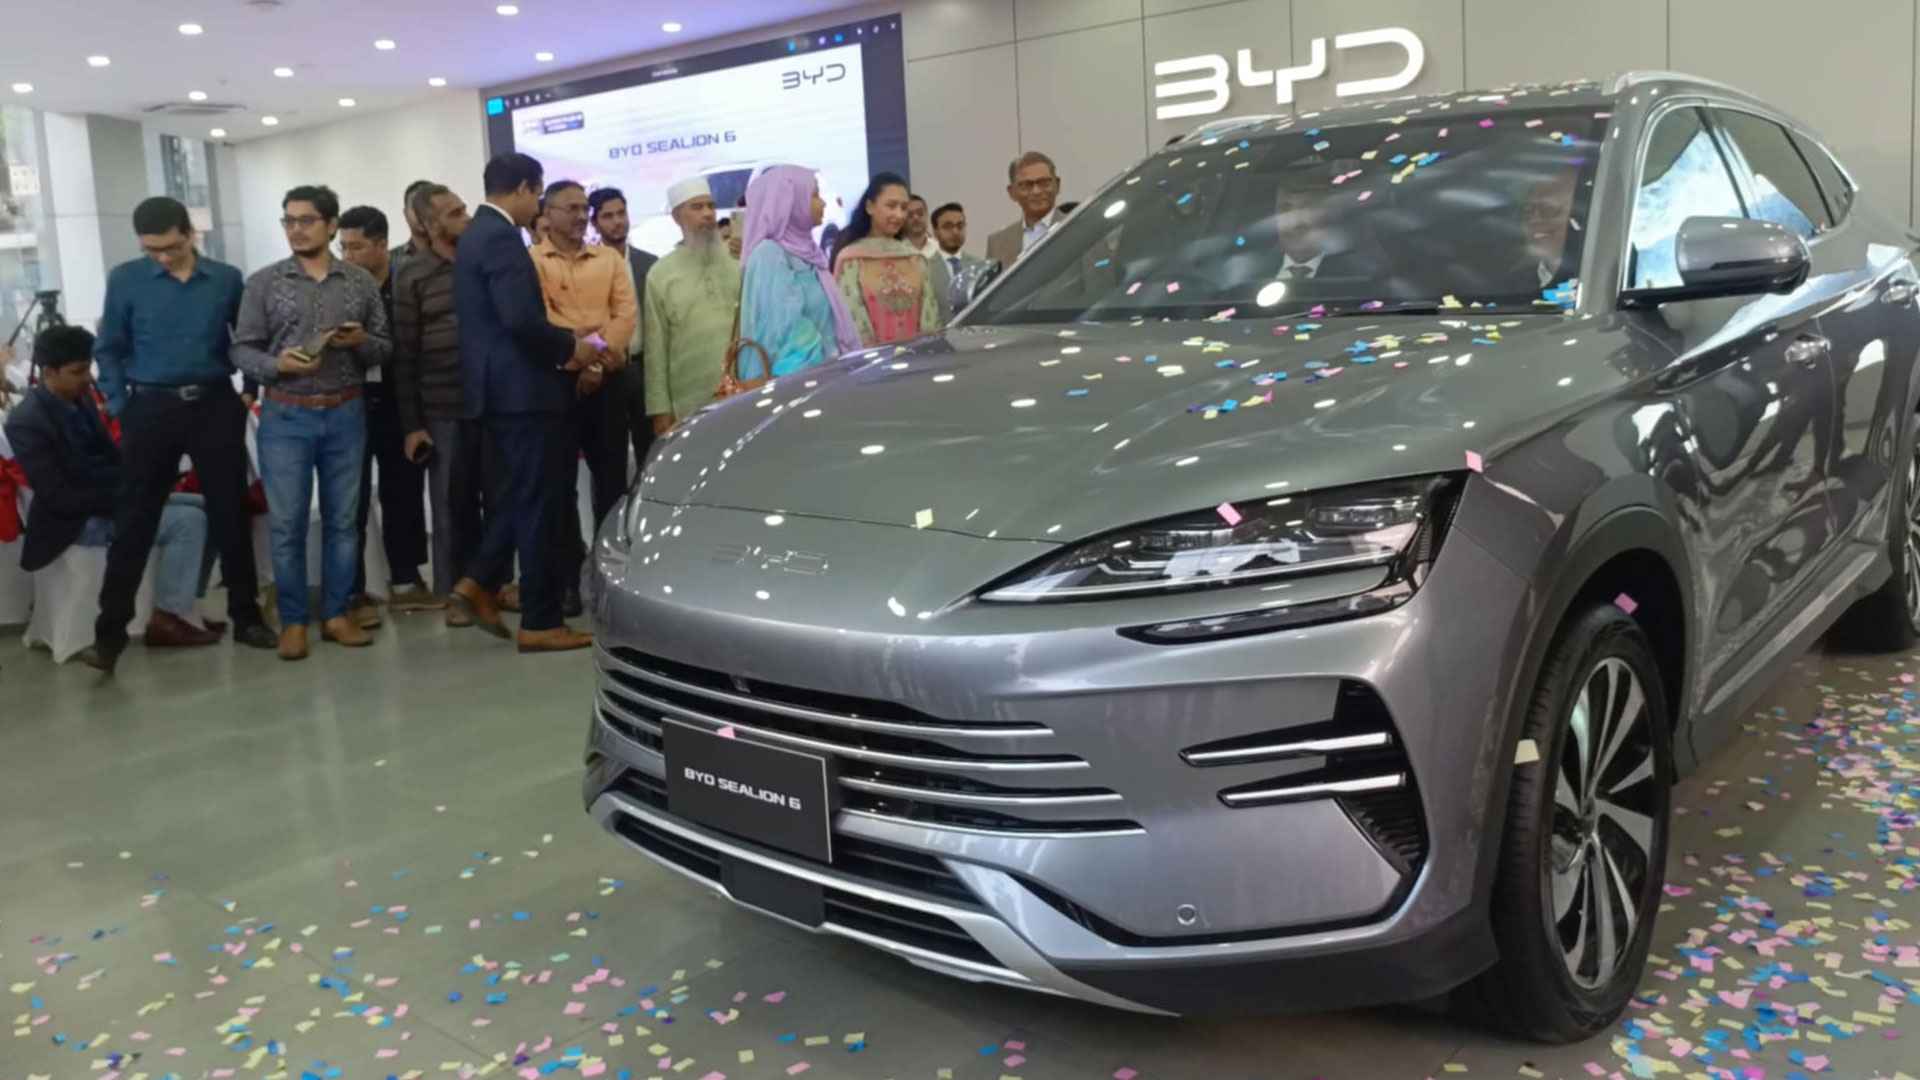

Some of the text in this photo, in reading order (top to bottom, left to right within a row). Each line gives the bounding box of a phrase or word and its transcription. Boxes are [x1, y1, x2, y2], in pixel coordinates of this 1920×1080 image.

[781, 63, 846, 90] BYD
[1154, 27, 1425, 120] BYD
[609, 130, 737, 160] BYD SEALION 6
[684, 767, 802, 811] BYD SEALION 6
